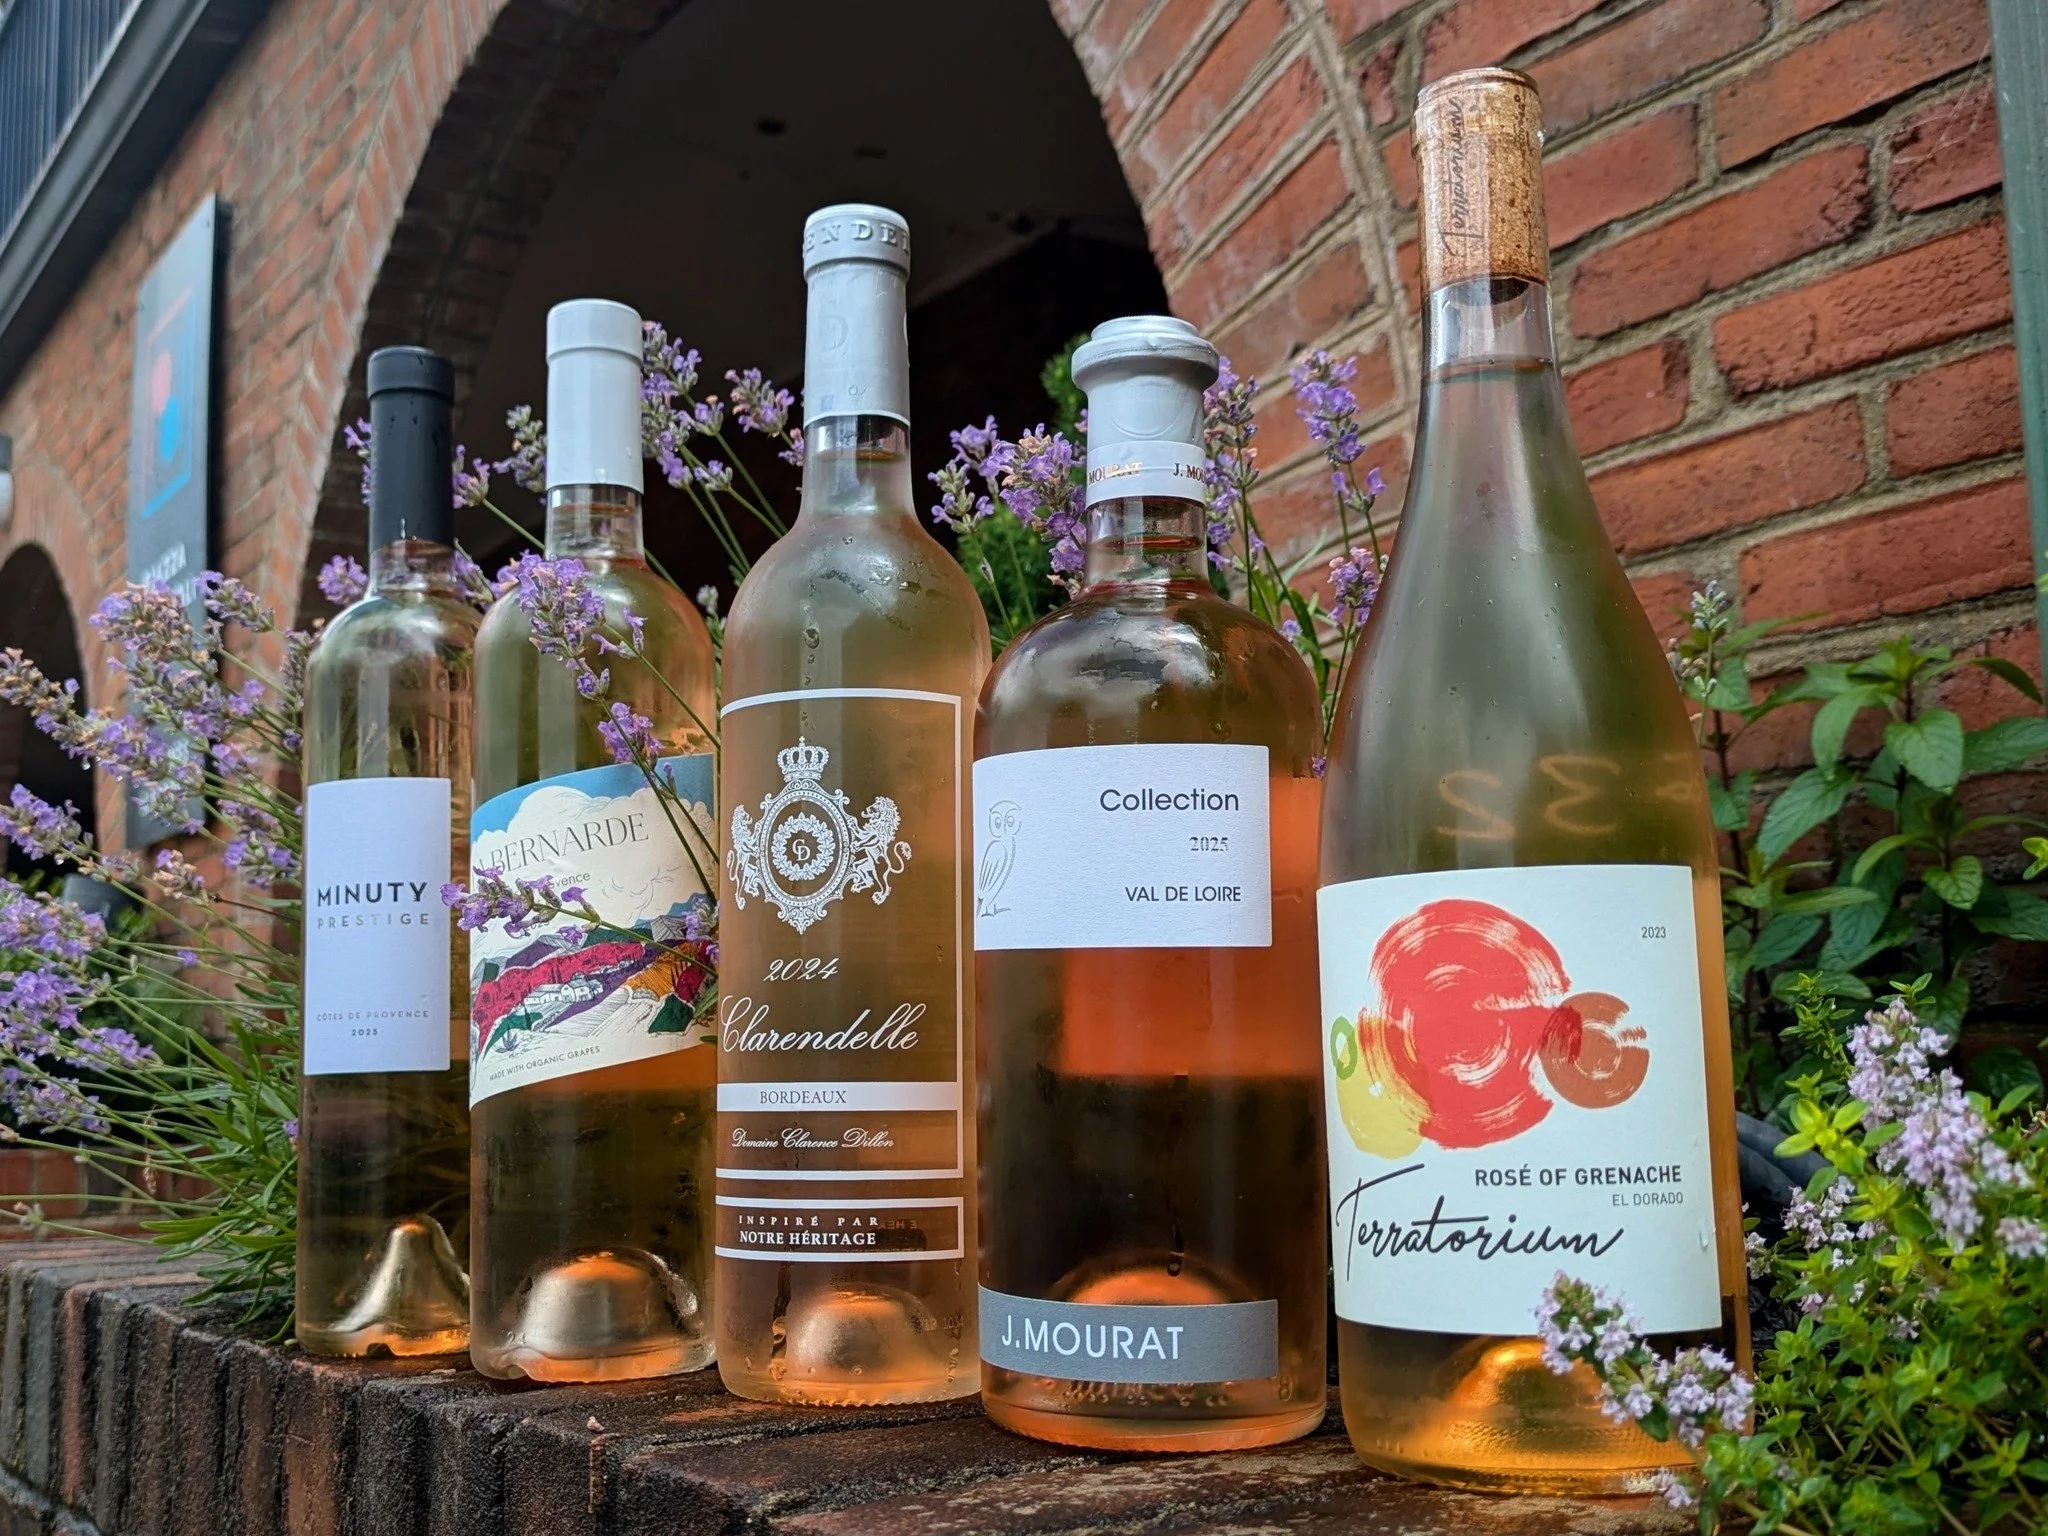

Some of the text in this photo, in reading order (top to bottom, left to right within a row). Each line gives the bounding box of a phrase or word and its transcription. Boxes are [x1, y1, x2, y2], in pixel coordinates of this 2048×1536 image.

[1173, 463, 1184, 477] J.
[1099, 788, 1240, 812] Collection
[490, 812, 649, 874] BERNARDE
[1189, 836, 1229, 852] 2025
[317, 881, 428, 907] MINUTY
[1125, 886, 1241, 902] VAL DE LOIRE
[317, 912, 430, 930] PRESTIGE
[1641, 925, 1667, 939] 2023
[763, 957, 840, 982] 2024
[348, 1010, 361, 1020] DE
[366, 1009, 429, 1019] PROVENCE
[720, 995, 927, 1052] Clarendelle
[351, 1028, 378, 1036] 2025
[489, 1045, 601, 1081] MADE WITH ORGANIC GRAPES
[759, 1090, 848, 1105] BORDEAUX
[731, 1127, 894, 1148] Domaine Clarence Dillon
[1475, 1163, 1682, 1186] ROSÉ OF GRENACHE
[1612, 1192, 1684, 1206] EL DORADO
[738, 1214, 879, 1226] INSPIRÉ PAR
[1335, 1163, 1625, 1282] Terratorium
[740, 1230, 876, 1245] NOTRE HÉRITAGE
[1002, 1314, 1184, 1360] J.MOURAT
